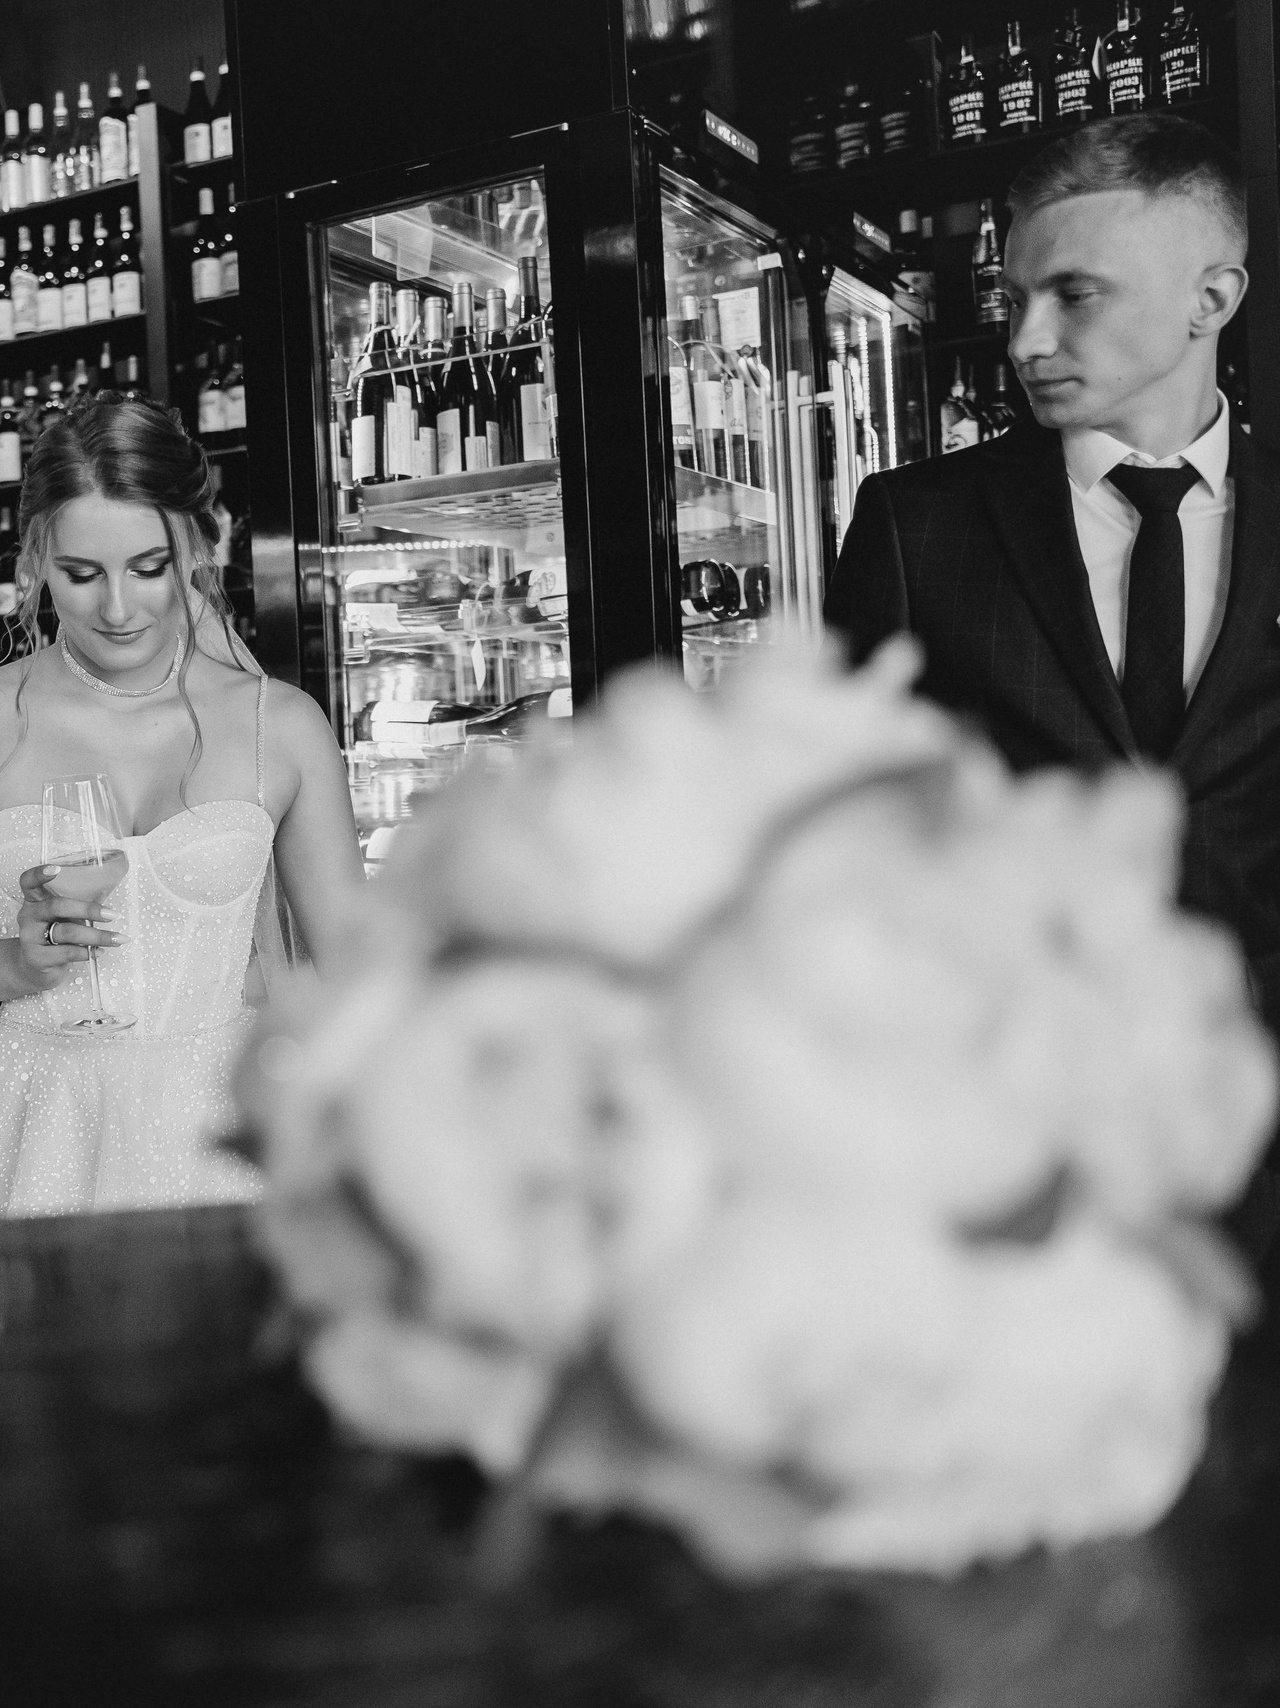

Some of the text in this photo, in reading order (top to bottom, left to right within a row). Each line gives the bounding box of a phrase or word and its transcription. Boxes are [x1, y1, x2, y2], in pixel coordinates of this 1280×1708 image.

[1160, 45, 1197, 62] KOPKE
[1106, 57, 1143, 72] KOPKE
[1171, 59, 1184, 70] 20
[1054, 69, 1090, 83] KOPKE
[1110, 75, 1139, 90] 2003
[998, 80, 1033, 95] KOPKE
[1058, 86, 1086, 100] 2003
[949, 91, 984, 106] KOPKE
[1003, 98, 1031, 112] 1987
